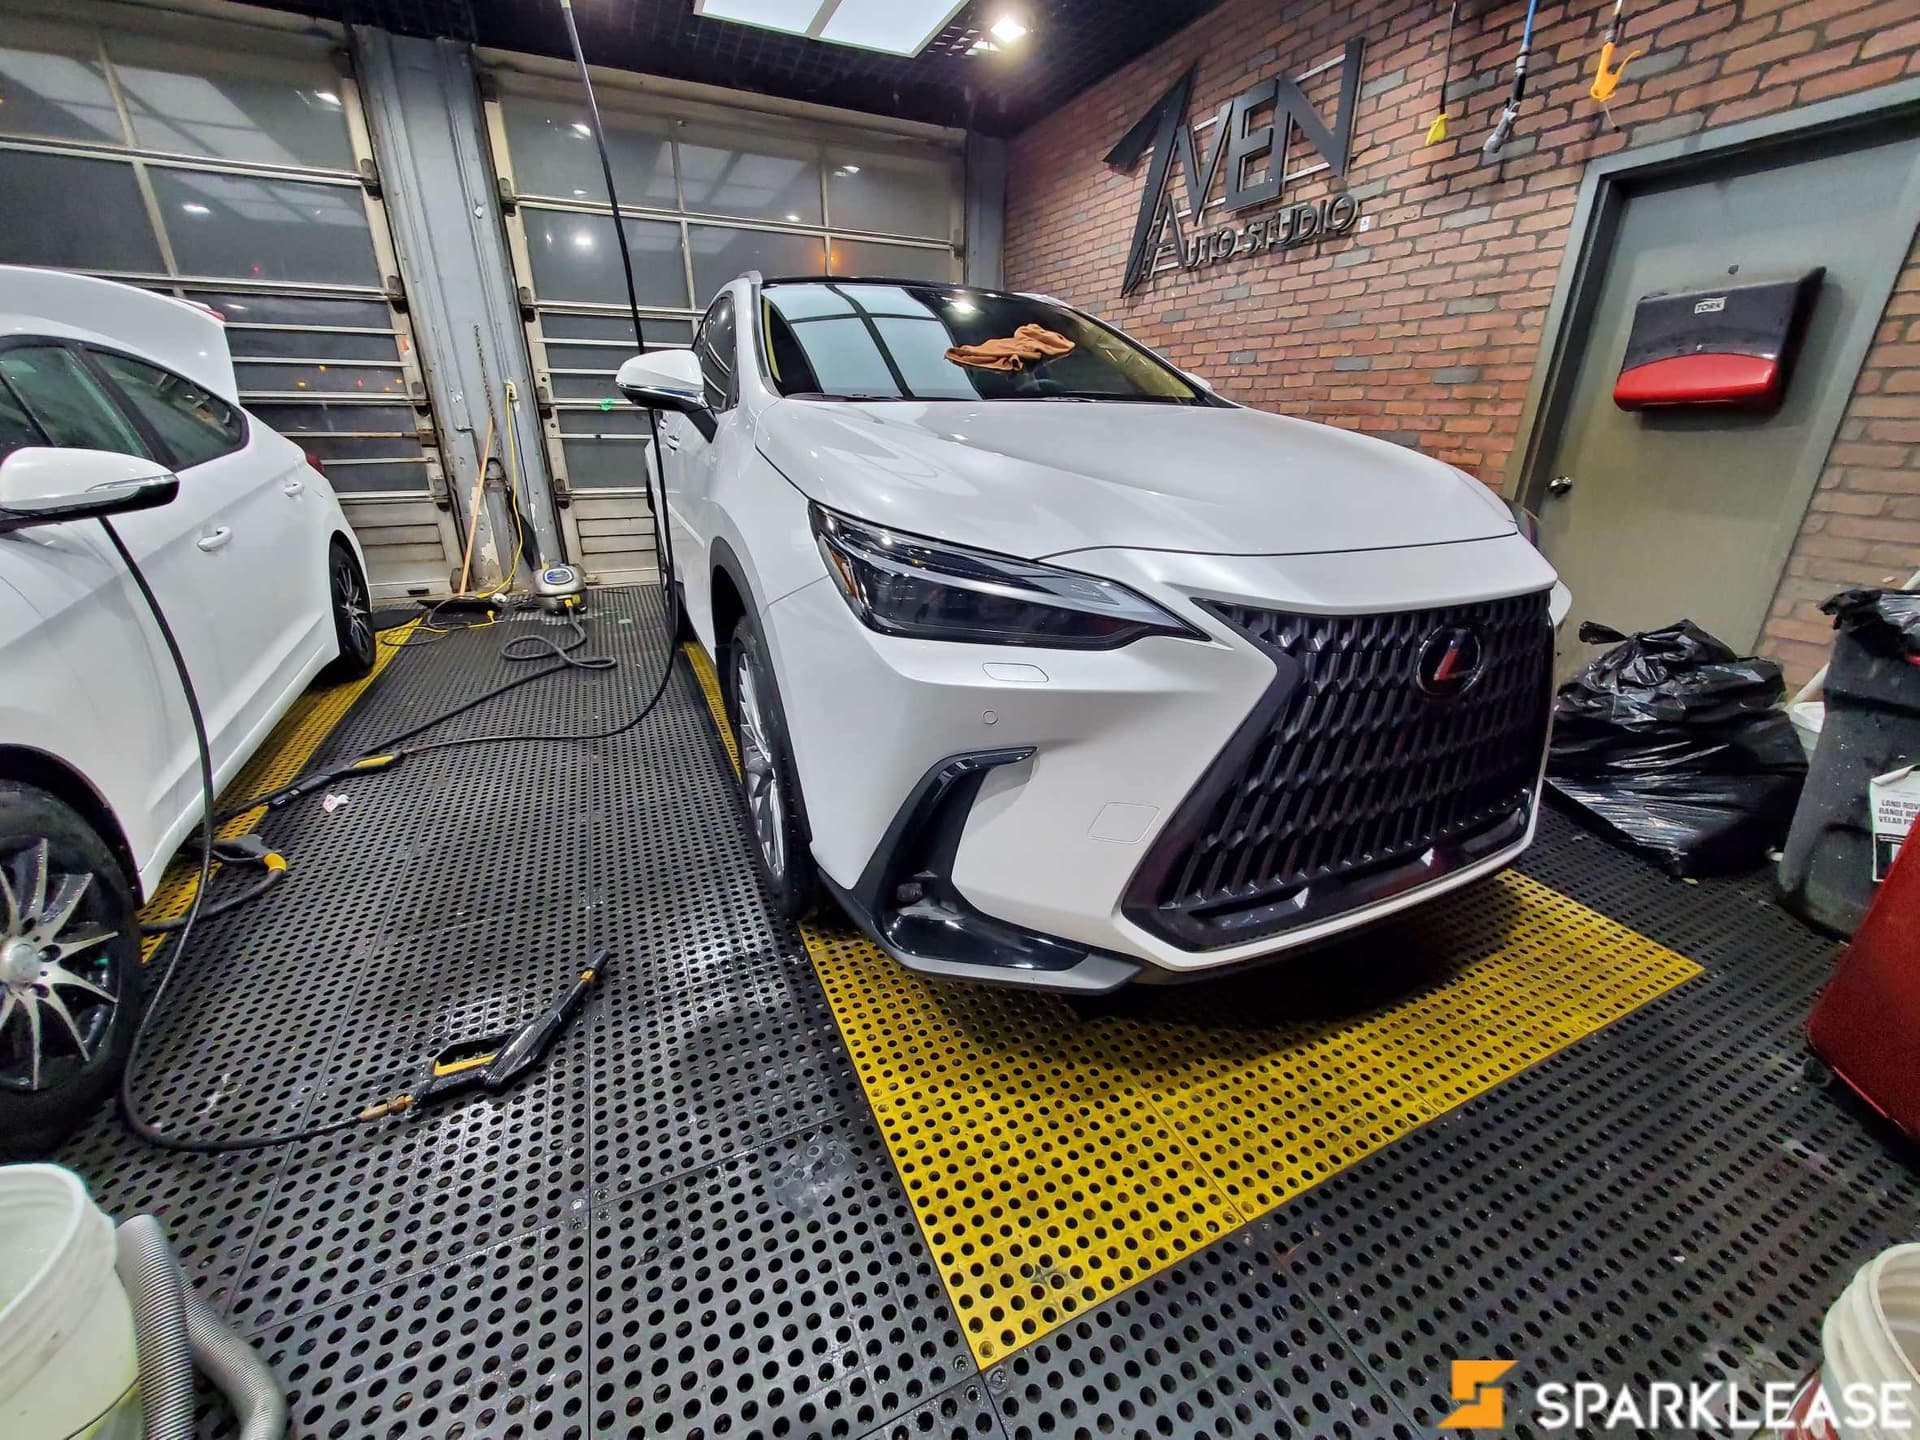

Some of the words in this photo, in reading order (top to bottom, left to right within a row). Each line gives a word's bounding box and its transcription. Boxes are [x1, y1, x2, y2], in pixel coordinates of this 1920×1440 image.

[1881, 800, 1901, 808] LAND
[1903, 801, 1920, 810] ROV
[1879, 807, 1903, 816] RANGE
[1878, 816, 1902, 824] VELAR
